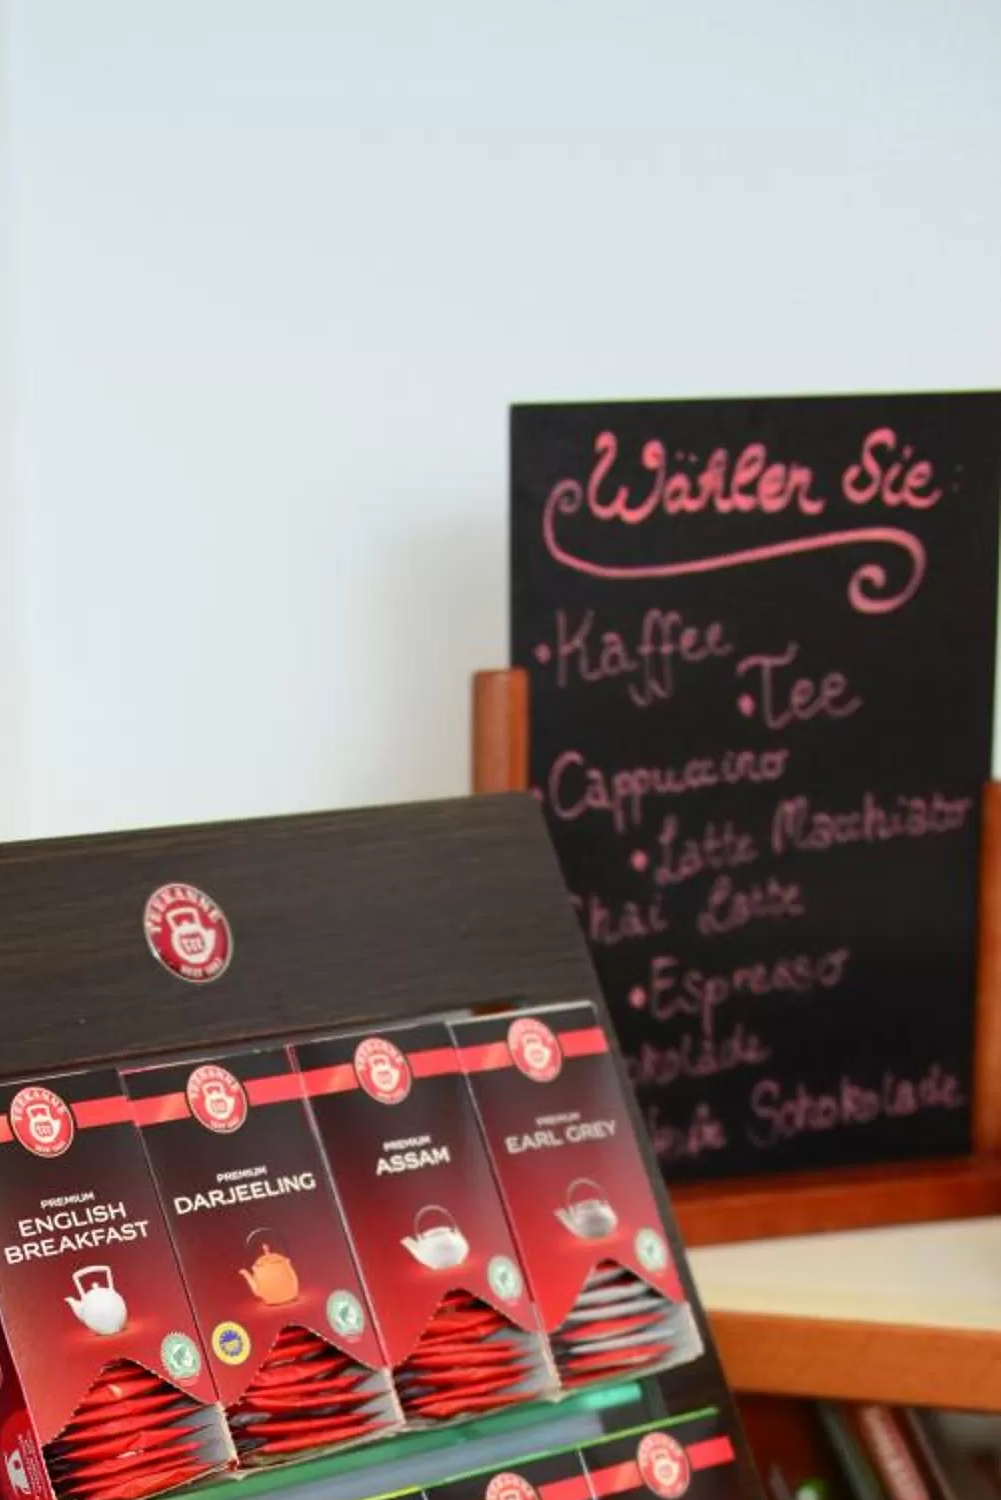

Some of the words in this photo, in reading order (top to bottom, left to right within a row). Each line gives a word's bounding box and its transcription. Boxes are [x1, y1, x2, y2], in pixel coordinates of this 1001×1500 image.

[588, 430, 824, 524] Wählen
[842, 427, 942, 508] Sie
[555, 608, 733, 707] Kaffee
[736, 641, 862, 730] Tee
[504, 1131, 562, 1155] EARL
[566, 1119, 617, 1144] GREY
[375, 1145, 451, 1176] ASSAM
[40, 1191, 95, 1208] PREMIUM
[174, 1172, 316, 1215] DARJEELING
[18, 1201, 127, 1237] ENGLISH
[4, 1220, 149, 1264] BREAKFAST
